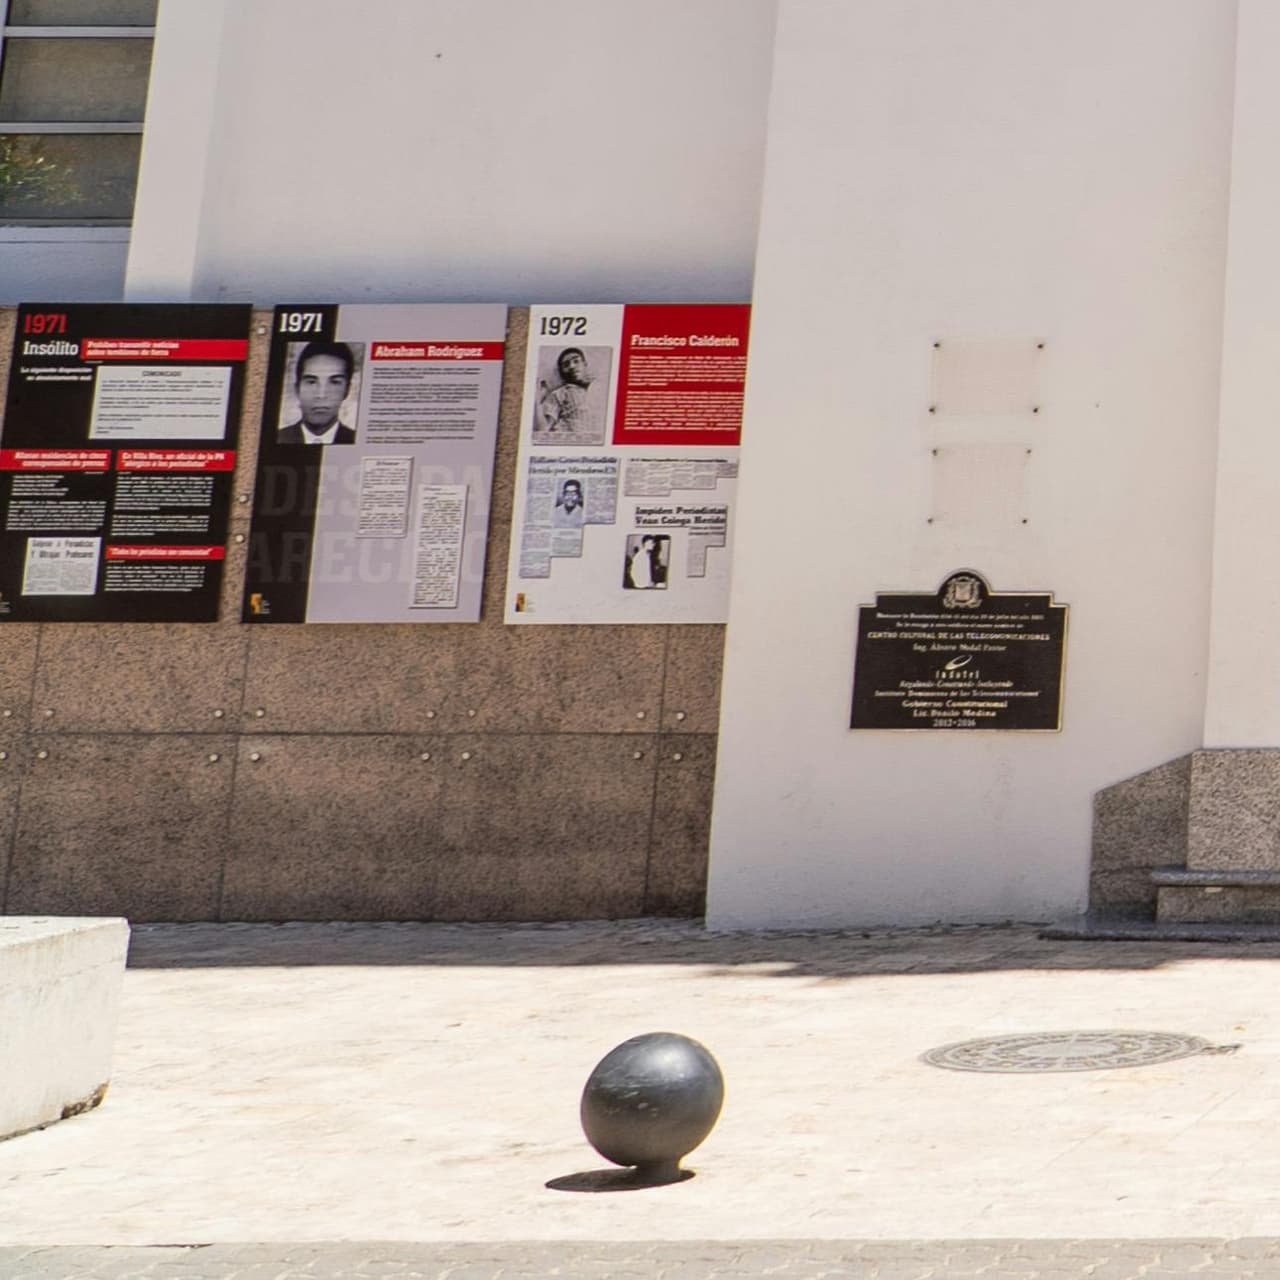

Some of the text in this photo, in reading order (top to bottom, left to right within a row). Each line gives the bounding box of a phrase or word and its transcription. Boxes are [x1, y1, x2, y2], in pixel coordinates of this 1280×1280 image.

[24, 314, 68, 334] 1971
[279, 312, 323, 333] 1971
[540, 316, 587, 336] 1972
[23, 340, 79, 356] Insólito
[631, 334, 687, 346] Francisco
[374, 345, 425, 357] Abraham
